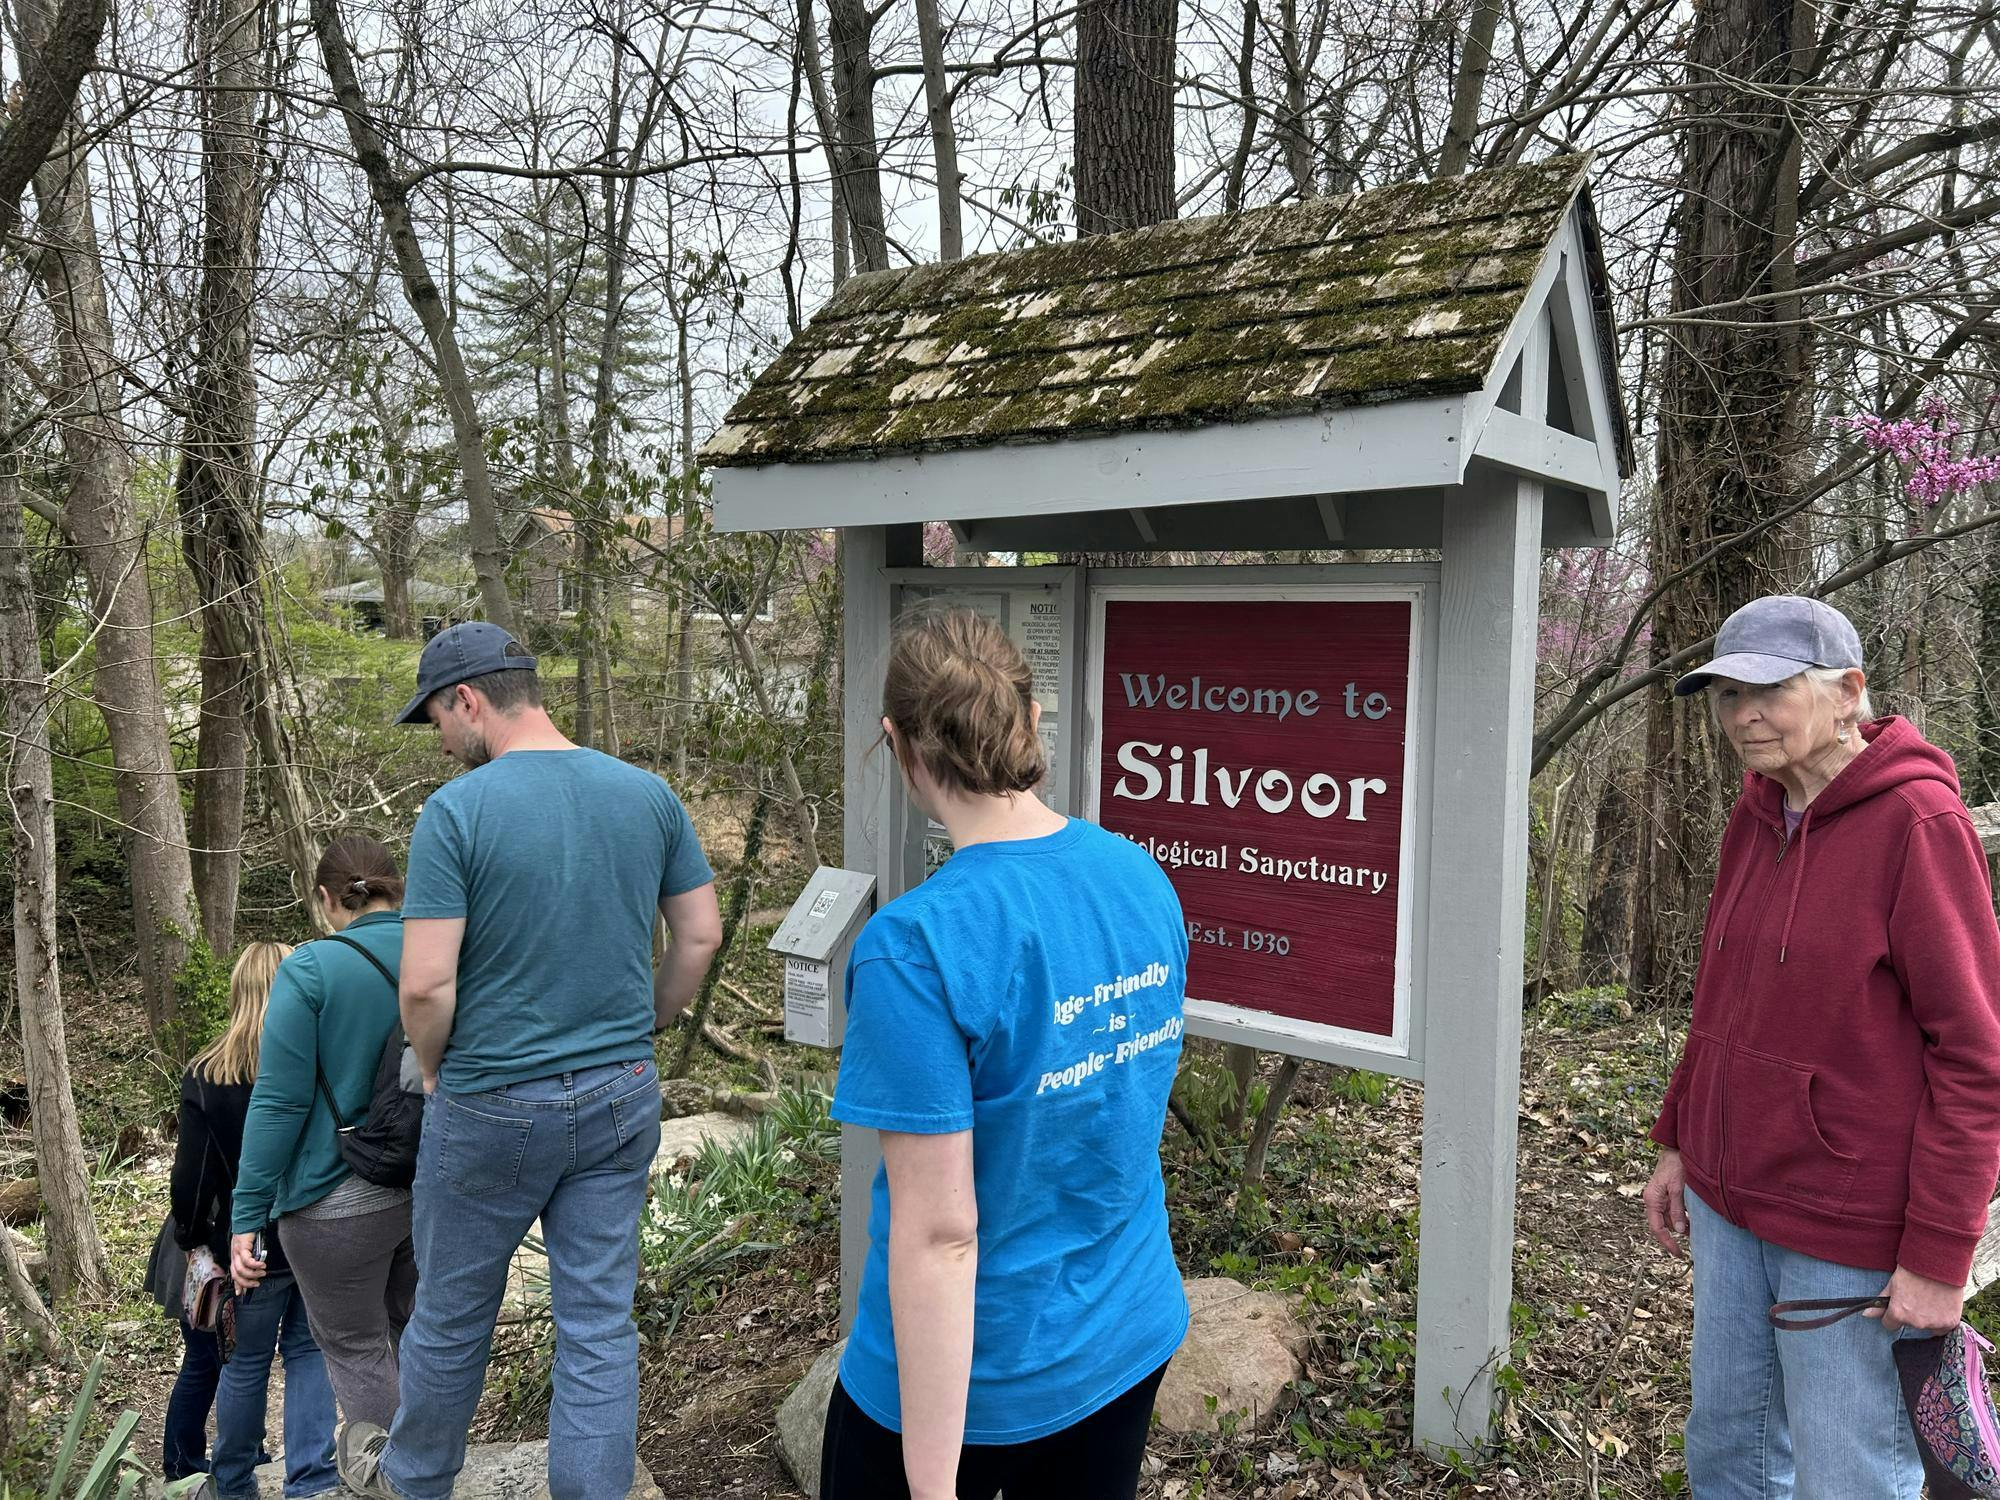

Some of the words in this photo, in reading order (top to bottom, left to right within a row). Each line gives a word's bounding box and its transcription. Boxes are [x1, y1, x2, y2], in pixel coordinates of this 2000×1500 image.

[1119, 672, 1320, 722] Welcome
[1342, 682, 1388, 720] to
[1113, 741, 1387, 821] Silvoor
[1112, 832, 1227, 869] logical
[1238, 847, 1388, 894] Sanctuary
[1187, 921, 1233, 947] Est.
[1243, 930, 1290, 956] 1930
[788, 959, 819, 974] NOTICE
[1108, 1012, 1127, 1033] is
